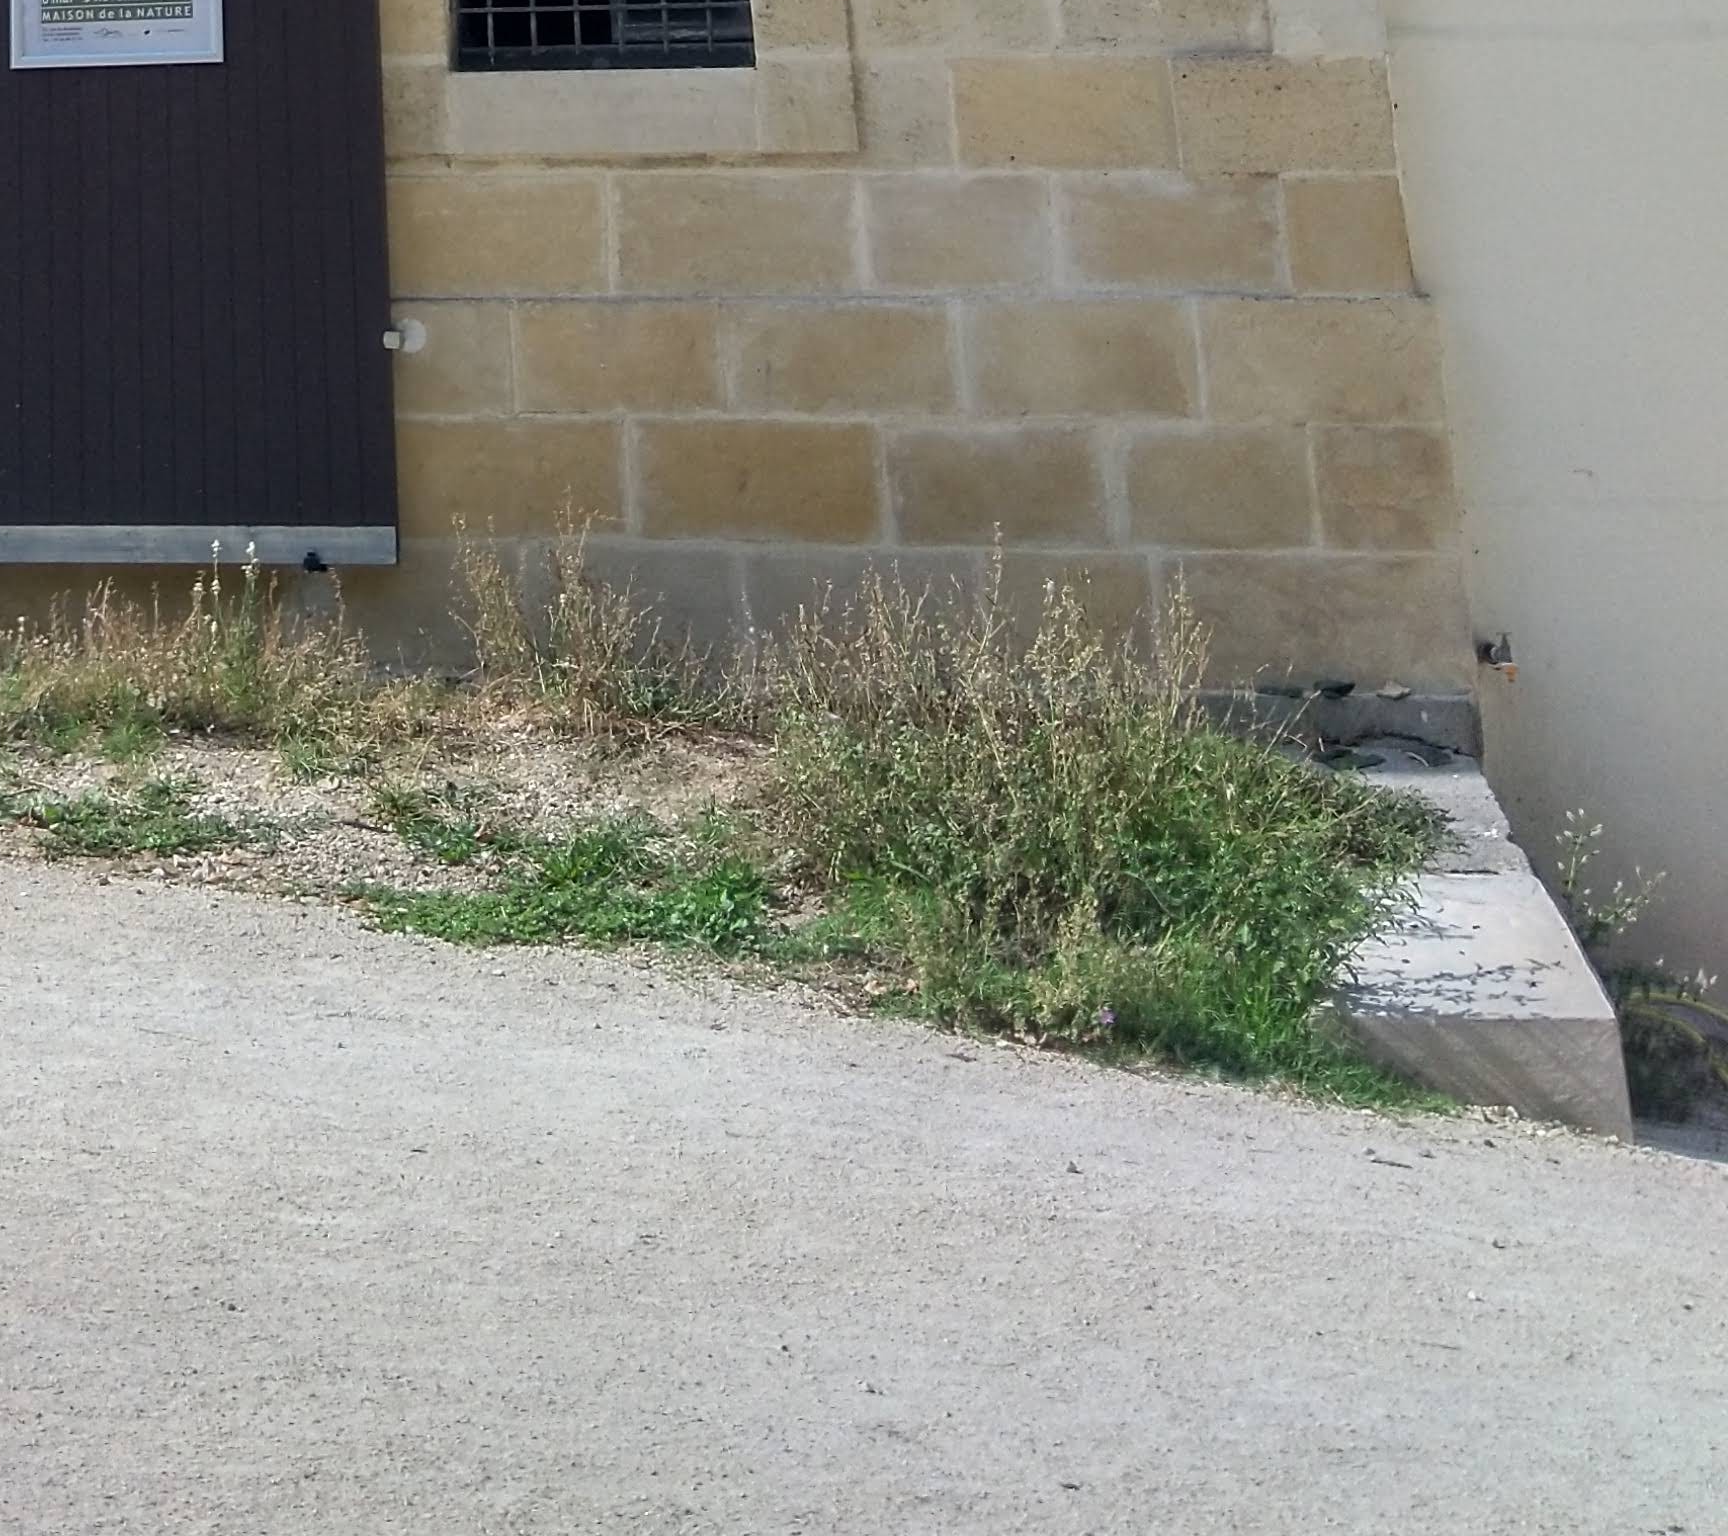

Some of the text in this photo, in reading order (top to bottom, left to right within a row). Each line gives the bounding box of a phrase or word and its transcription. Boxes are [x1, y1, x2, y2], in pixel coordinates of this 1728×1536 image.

[42, 6, 192, 21] MAISON de la NATURE
